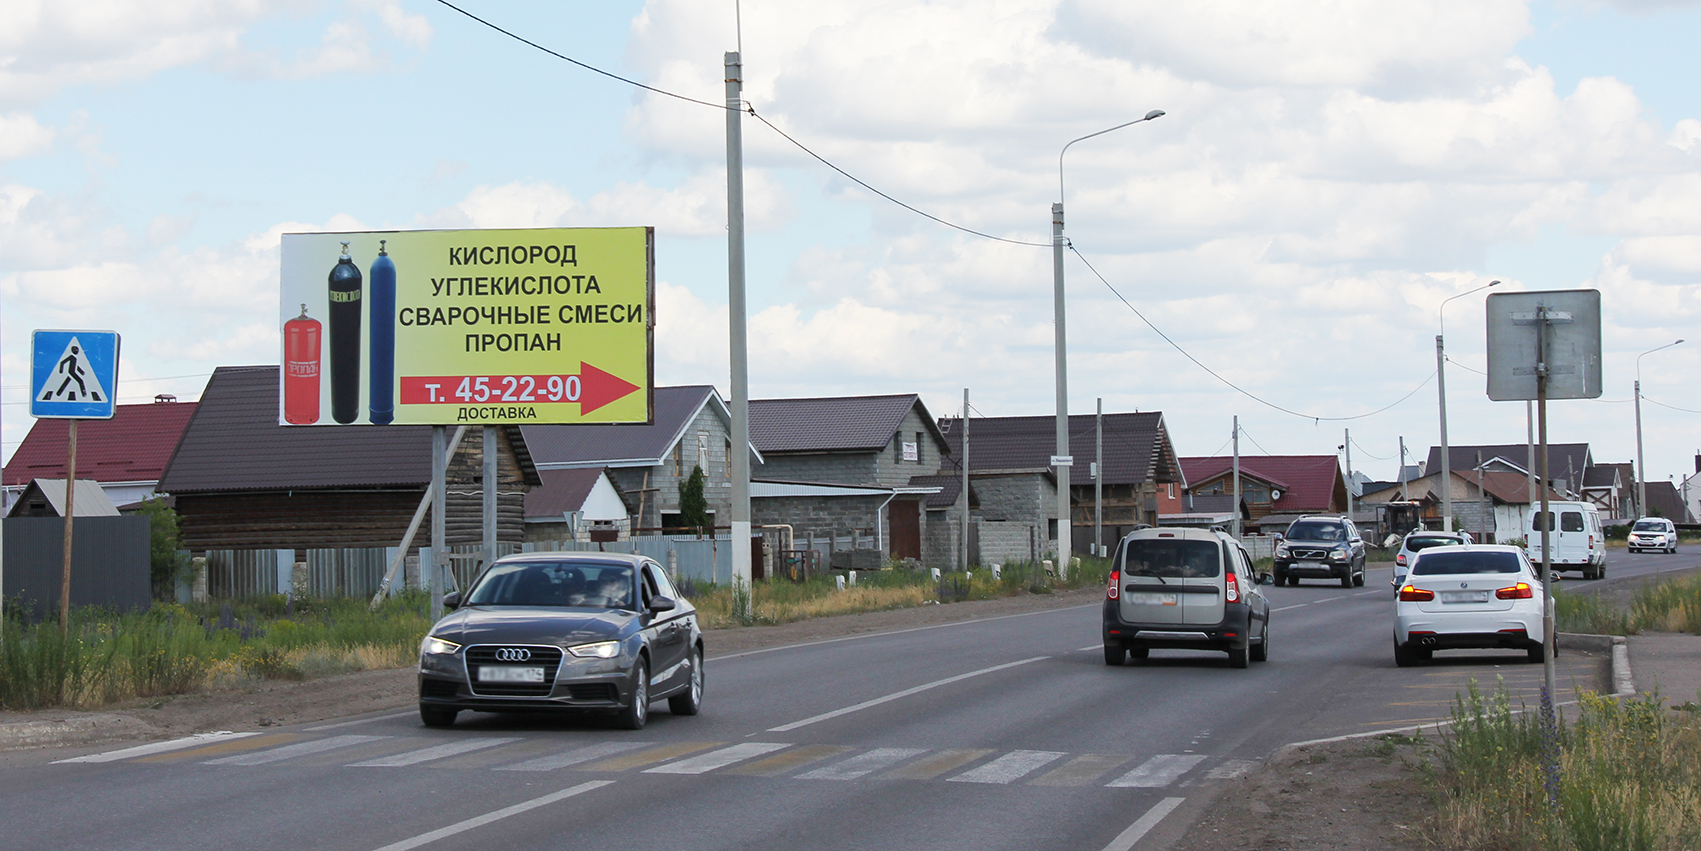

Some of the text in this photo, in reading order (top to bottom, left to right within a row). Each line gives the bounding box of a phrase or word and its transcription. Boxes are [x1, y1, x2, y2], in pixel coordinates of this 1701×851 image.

[449, 245, 578, 267] КИСЛОРОД
[431, 275, 602, 297] УГЛЕКИСЛОТА
[399, 304, 643, 326] СВАРОЧНЫЕ СМЕСИ
[465, 333, 561, 352] ПРОПАН
[287, 362, 319, 374] ПРОПАН
[425, 375, 582, 403] т. 45-22-90
[457, 406, 537, 421] ДОСТАВКА
